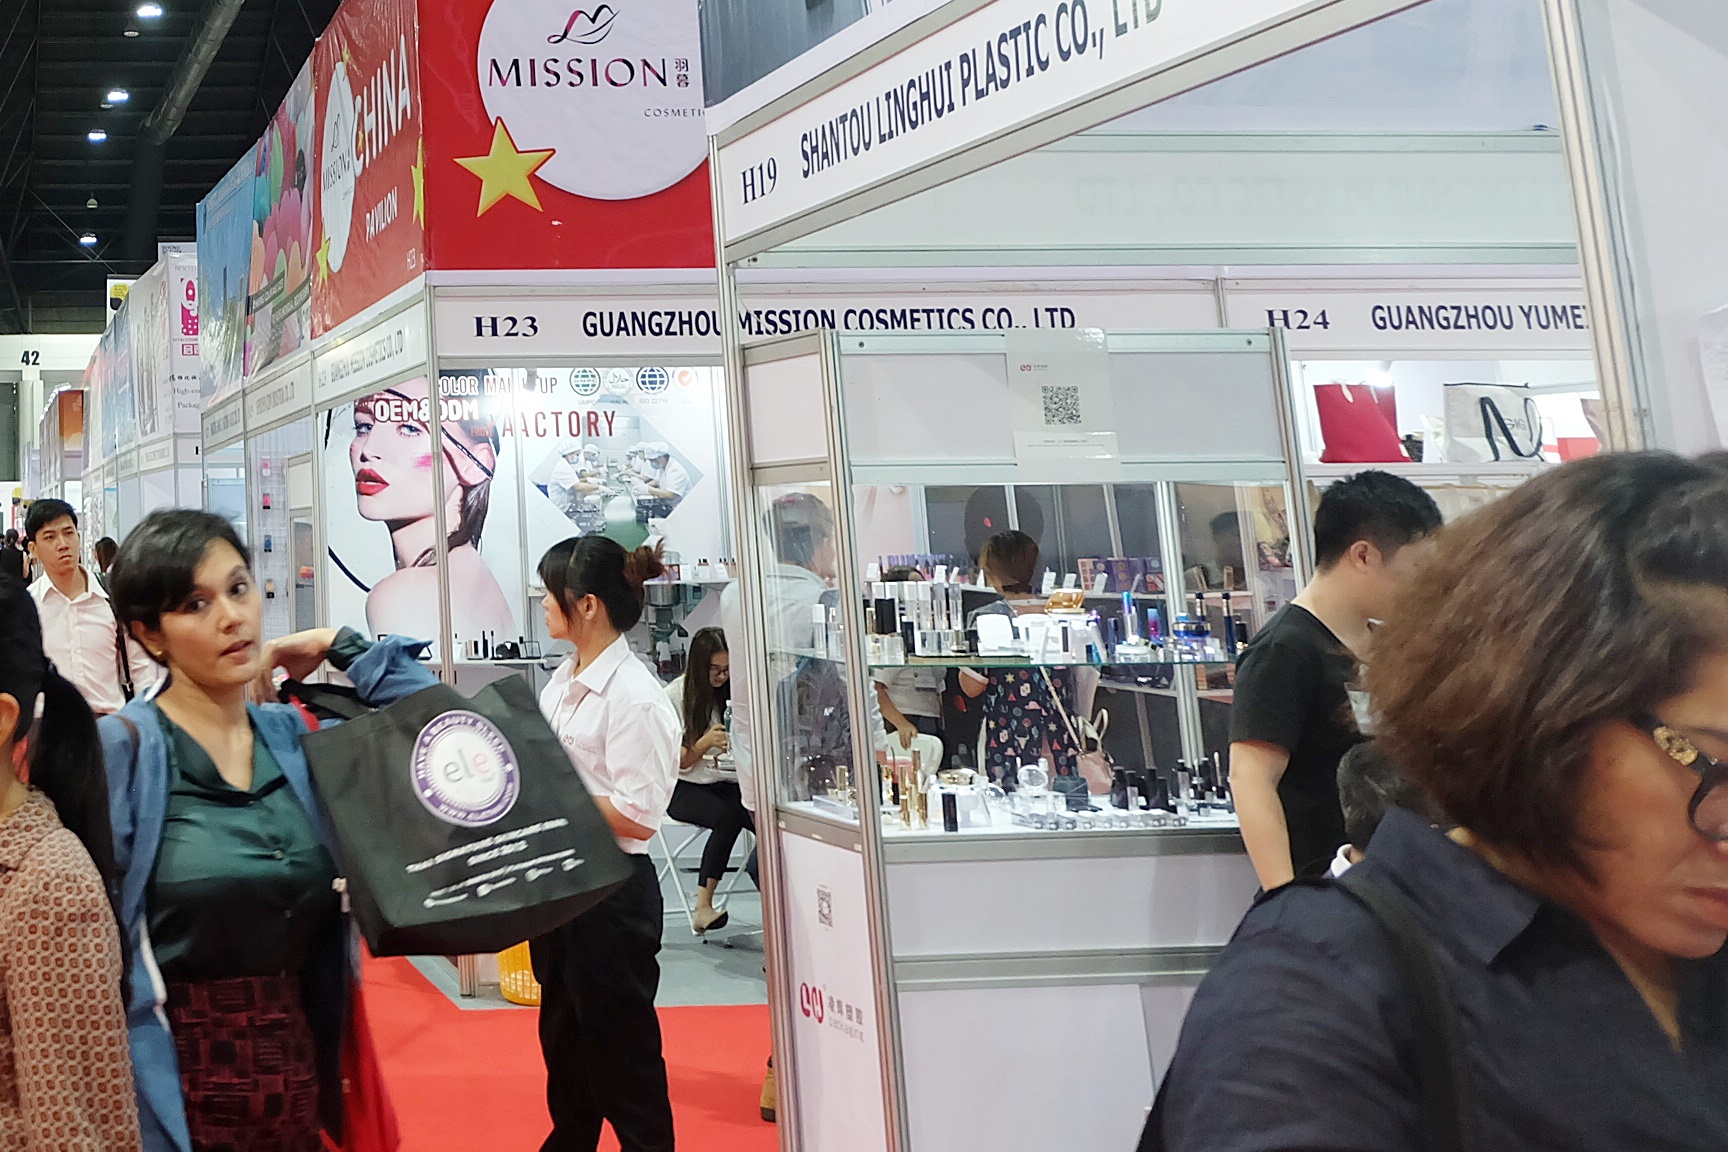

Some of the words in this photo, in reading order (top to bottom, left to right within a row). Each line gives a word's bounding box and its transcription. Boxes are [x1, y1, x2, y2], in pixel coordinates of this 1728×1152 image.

[488, 57, 668, 88] MISSION
[352, 34, 412, 177] CHINA
[643, 108, 703, 118] COSMETI
[740, 157, 779, 205] H19
[800, 95, 872, 180] SHANTOU
[875, 59, 956, 145] LINGHUI
[960, 12, 1051, 107] PLASTIC
[365, 186, 399, 243] PAVILION
[473, 315, 539, 337] H23
[737, 309, 836, 336] MISSION
[843, 307, 975, 329] COSMETICS
[1265, 308, 1330, 331] H24
[1371, 304, 1514, 331] GUANGZHOU
[1517, 304, 1591, 330] YUME
[21, 350, 40, 366] 42
[539, 377, 558, 394] UP
